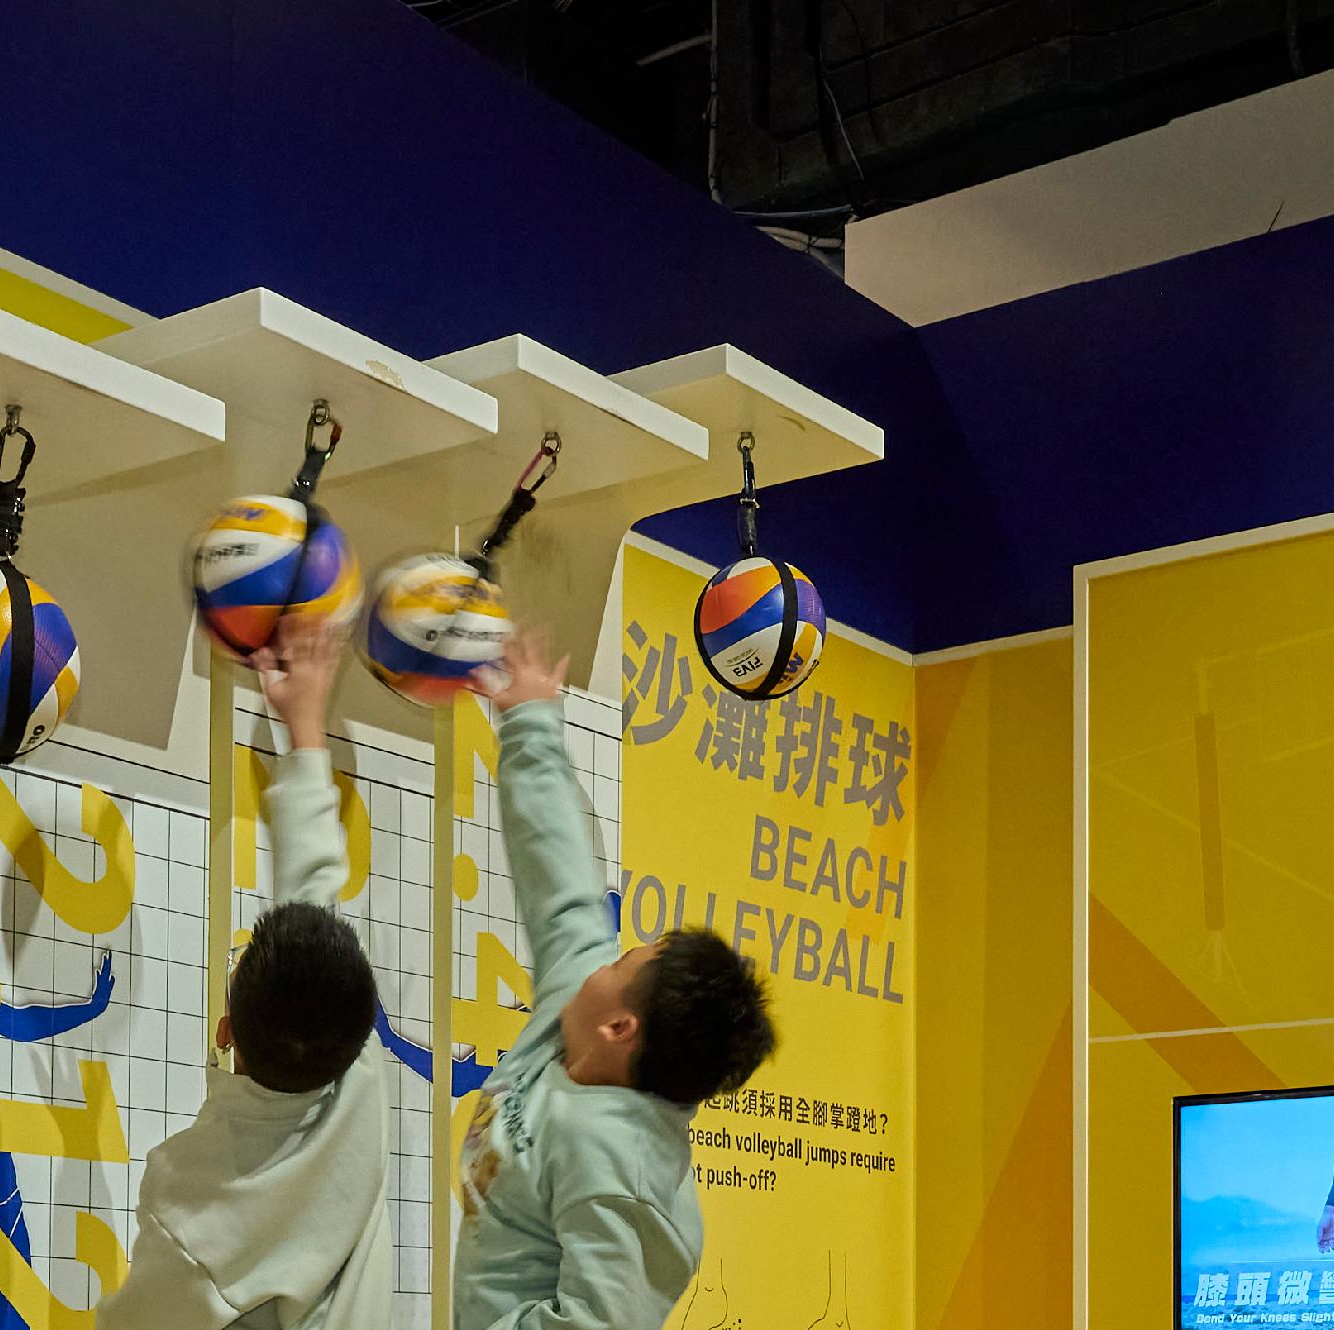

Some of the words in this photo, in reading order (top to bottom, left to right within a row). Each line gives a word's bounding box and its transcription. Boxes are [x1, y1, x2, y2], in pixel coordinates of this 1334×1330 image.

[622, 620, 912, 826] 沙灘排球
[750, 815, 907, 920] BEACH
[688, 1122, 731, 1149] beach
[735, 1132, 803, 1162] volleyball
[805, 1140, 847, 1169] jumps
[850, 1151, 896, 1175] require
[706, 1164, 777, 1192] push-off?
[1229, 1312, 1257, 1324] Your
